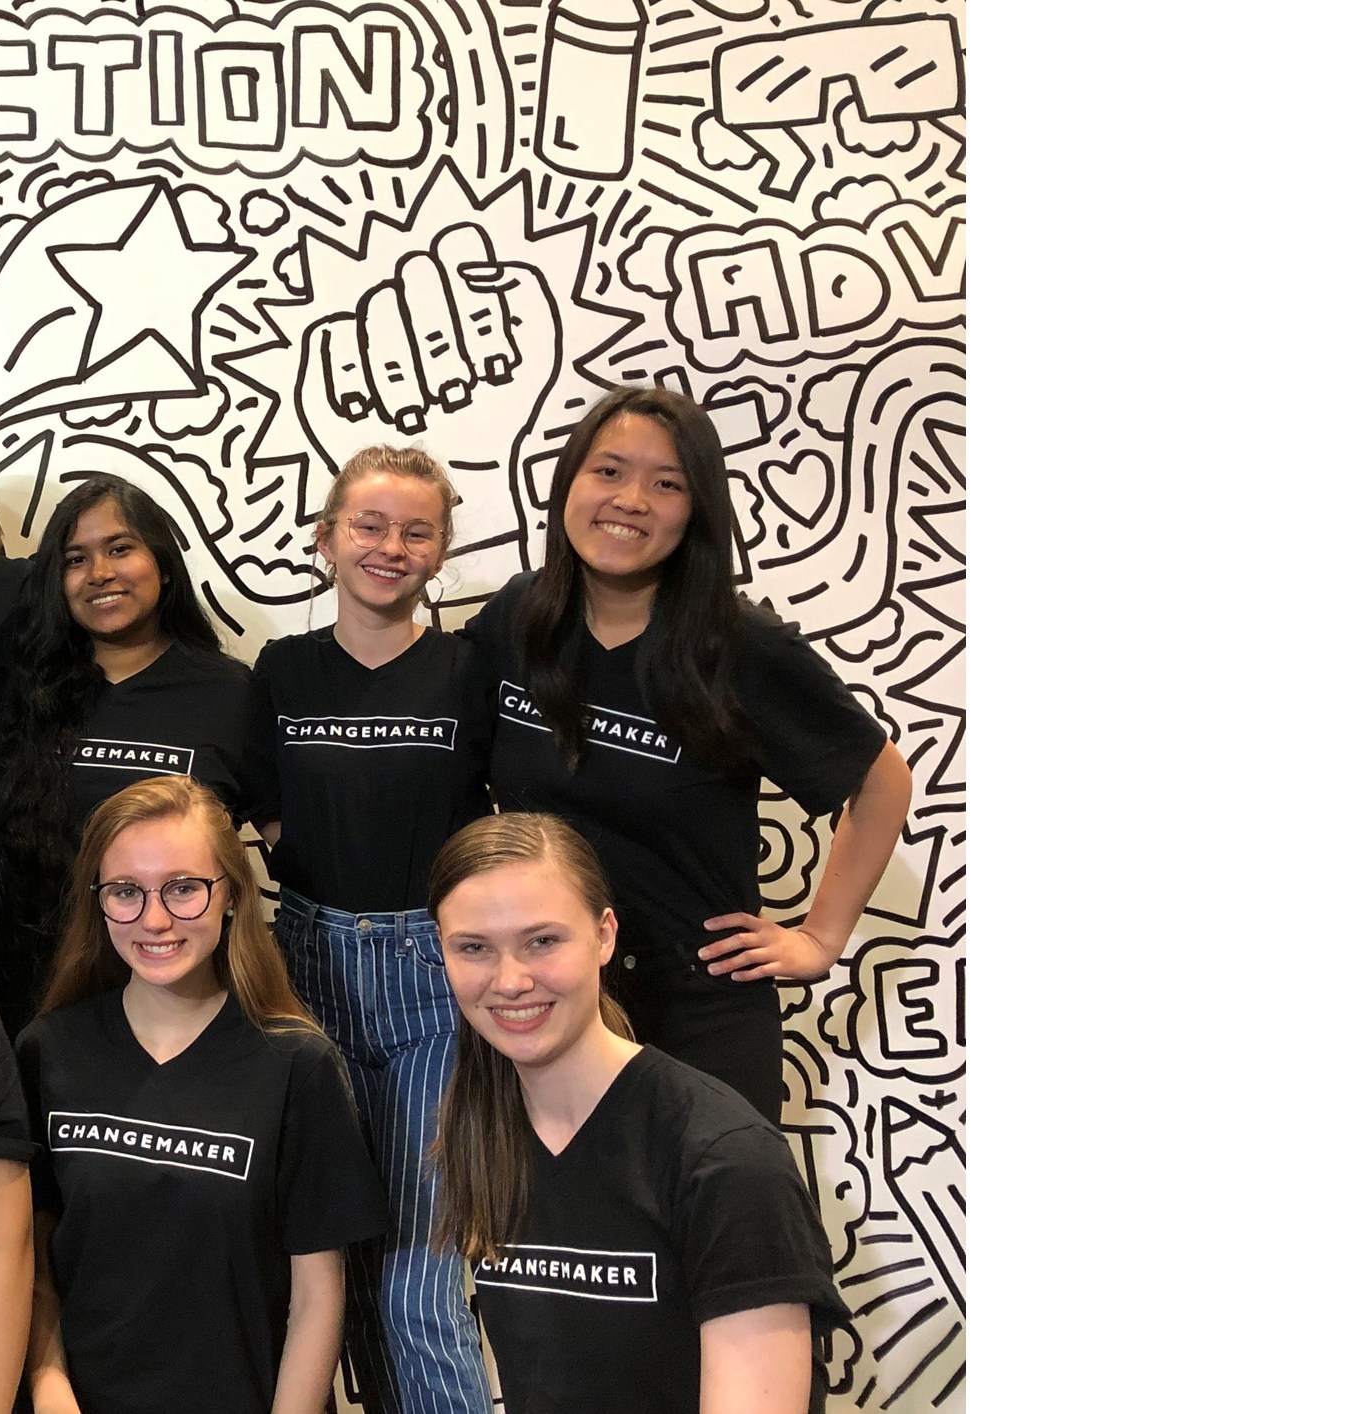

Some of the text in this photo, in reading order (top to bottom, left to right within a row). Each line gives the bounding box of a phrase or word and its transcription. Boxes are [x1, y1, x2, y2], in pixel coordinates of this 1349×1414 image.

[688, 217, 966, 345] ADV
[285, 724, 444, 738] CHANGEMAKER
[872, 957, 966, 1060] E
[57, 1123, 236, 1163] CHANGEMAKER
[481, 1255, 638, 1286] CHANGEMAKER
